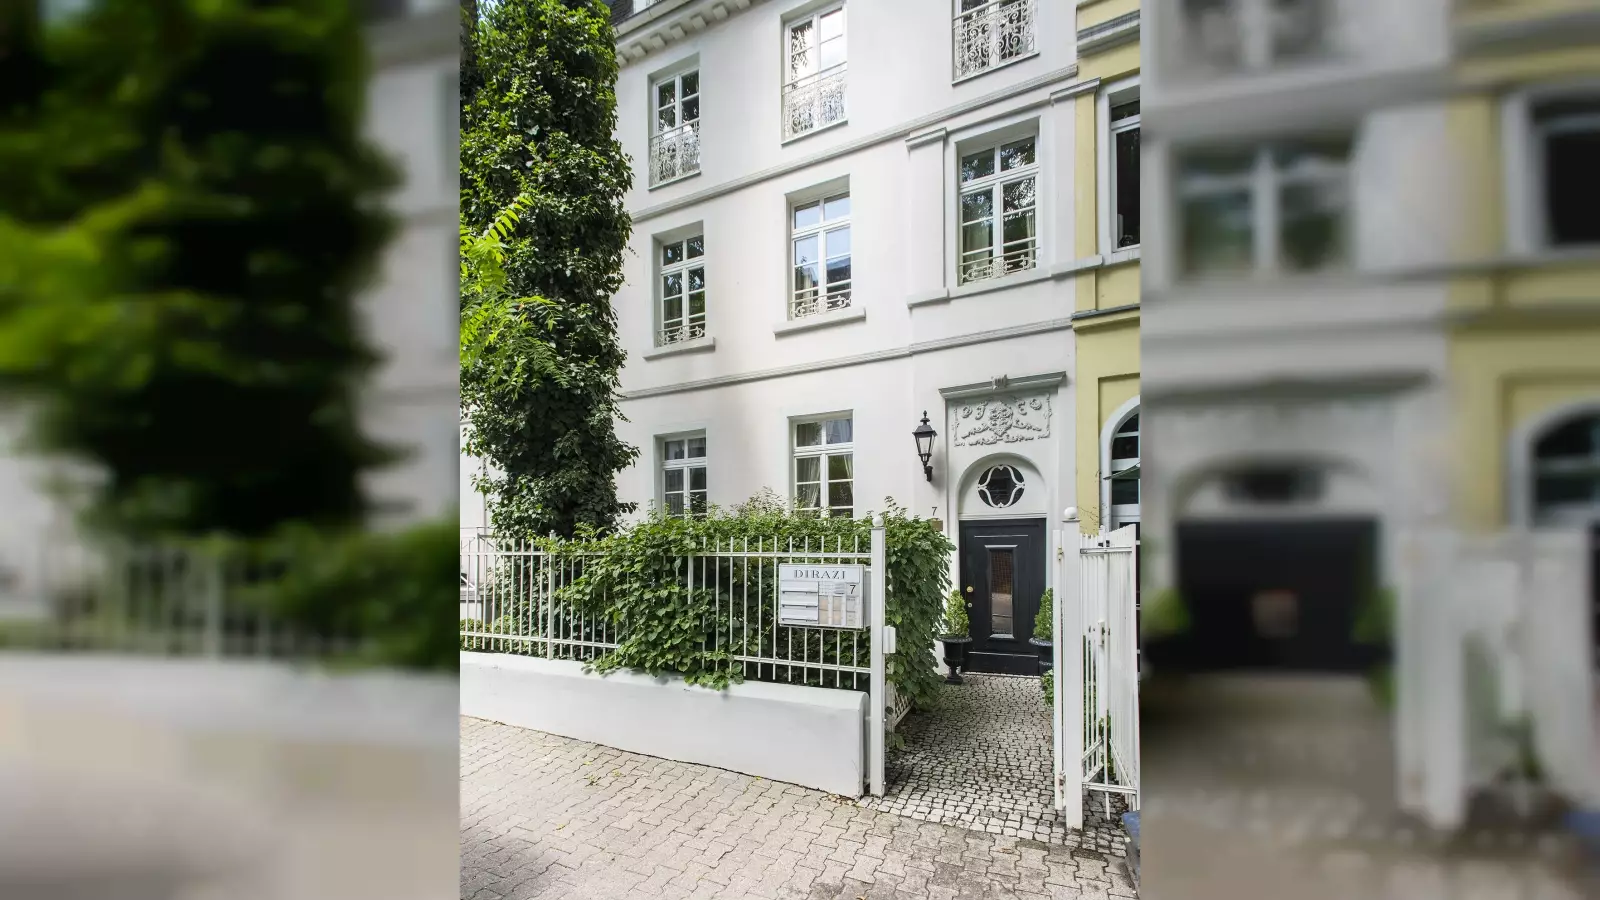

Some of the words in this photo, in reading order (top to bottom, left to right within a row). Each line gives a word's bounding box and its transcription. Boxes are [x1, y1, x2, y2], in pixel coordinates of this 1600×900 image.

[931, 506, 938, 516] 7
[794, 569, 846, 579] DIRAZI
[849, 585, 856, 595] 7
